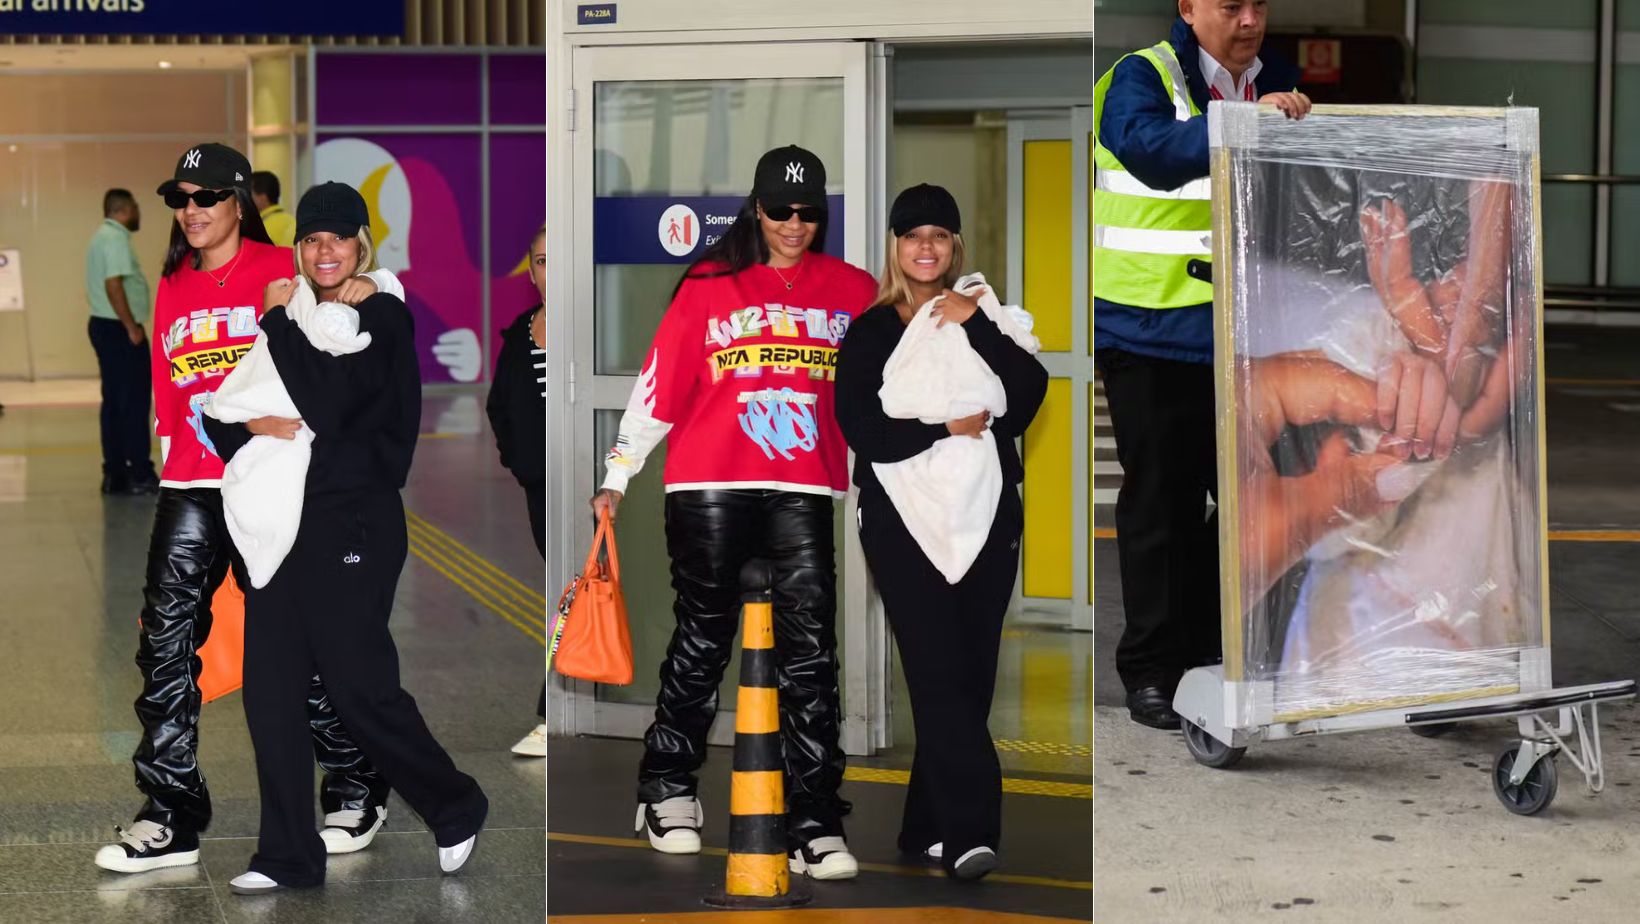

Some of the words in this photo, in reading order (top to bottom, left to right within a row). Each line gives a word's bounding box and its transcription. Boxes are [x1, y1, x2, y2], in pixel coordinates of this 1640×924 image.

[32, 0, 145, 12] arrivals
[183, 148, 202, 169] NY
[784, 161, 805, 184] NY
[343, 551, 361, 563] alo
